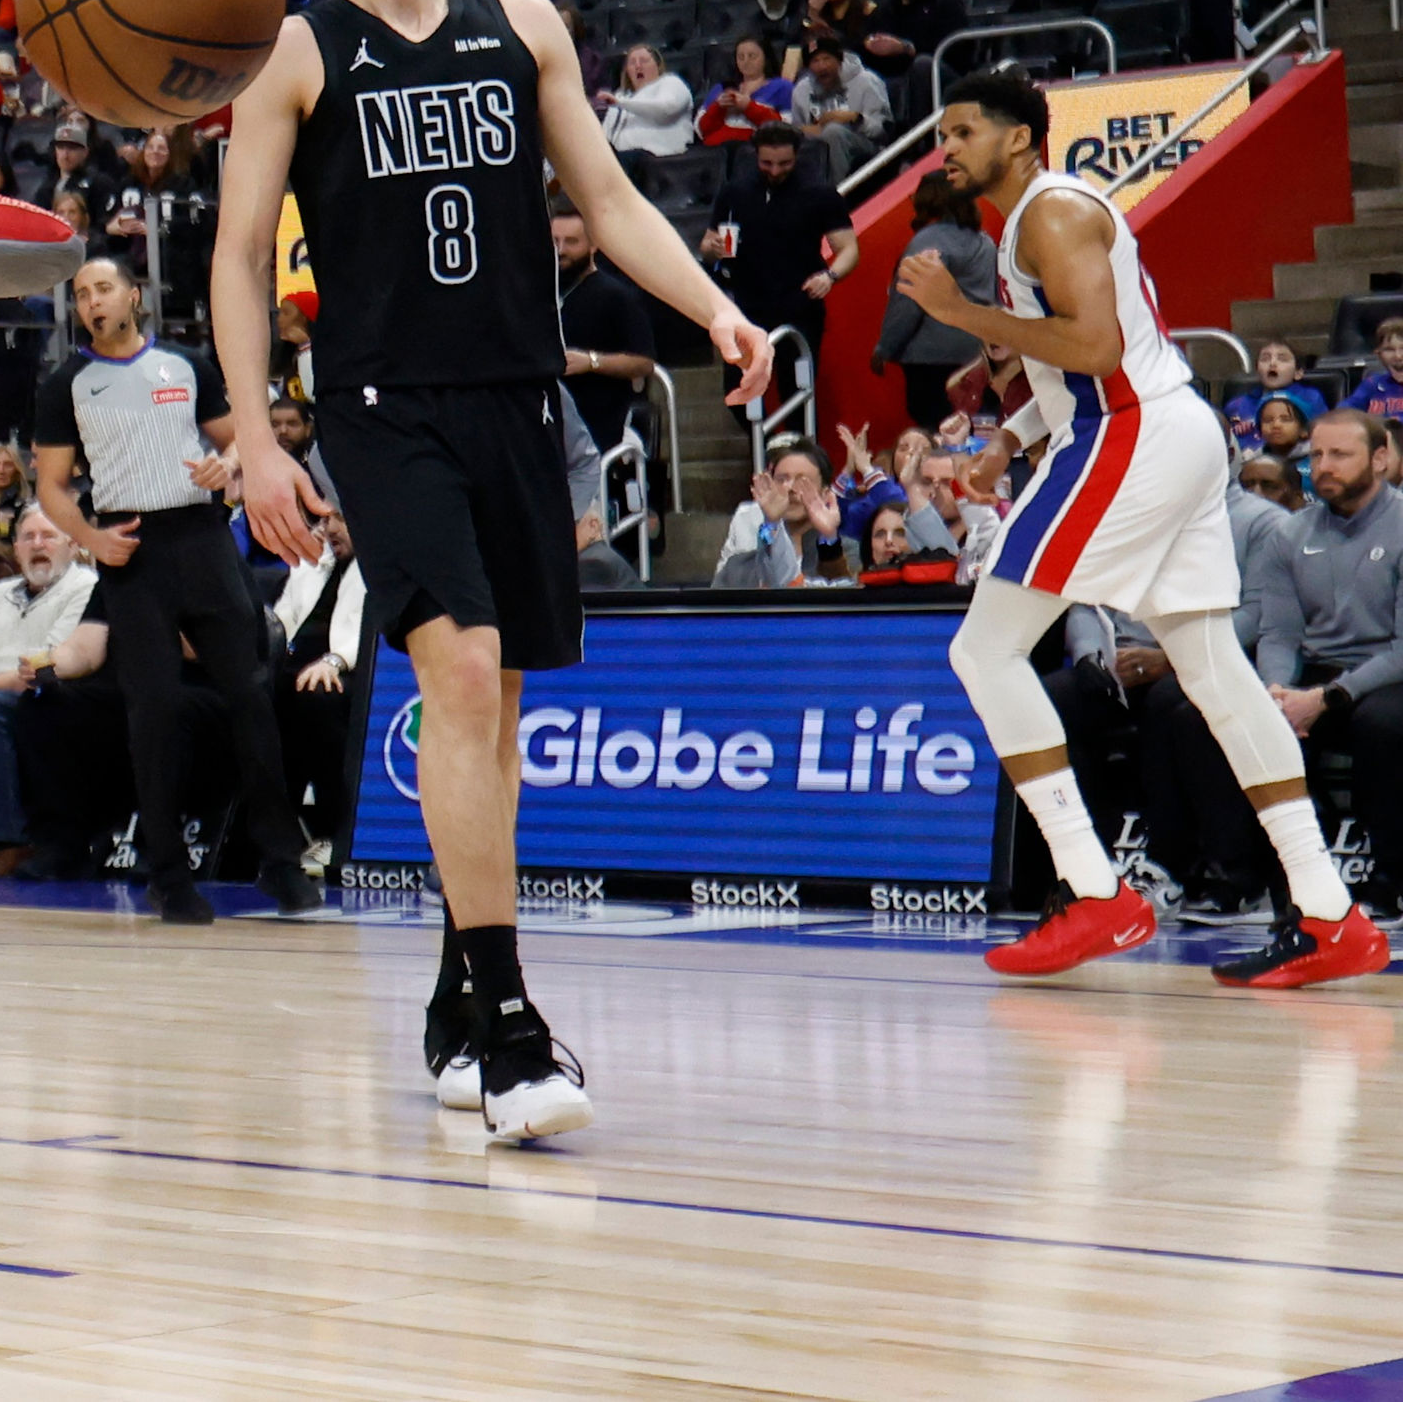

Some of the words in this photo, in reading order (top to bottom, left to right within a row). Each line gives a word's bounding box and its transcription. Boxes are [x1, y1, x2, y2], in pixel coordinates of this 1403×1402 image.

[355, 79, 516, 179] NETS
[1106, 111, 1175, 141] BET
[425, 184, 478, 285] 8
[518, 706, 774, 792] Globe
[797, 702, 976, 796] Life
[691, 879, 800, 908] StockX
[870, 884, 987, 914] StockX
